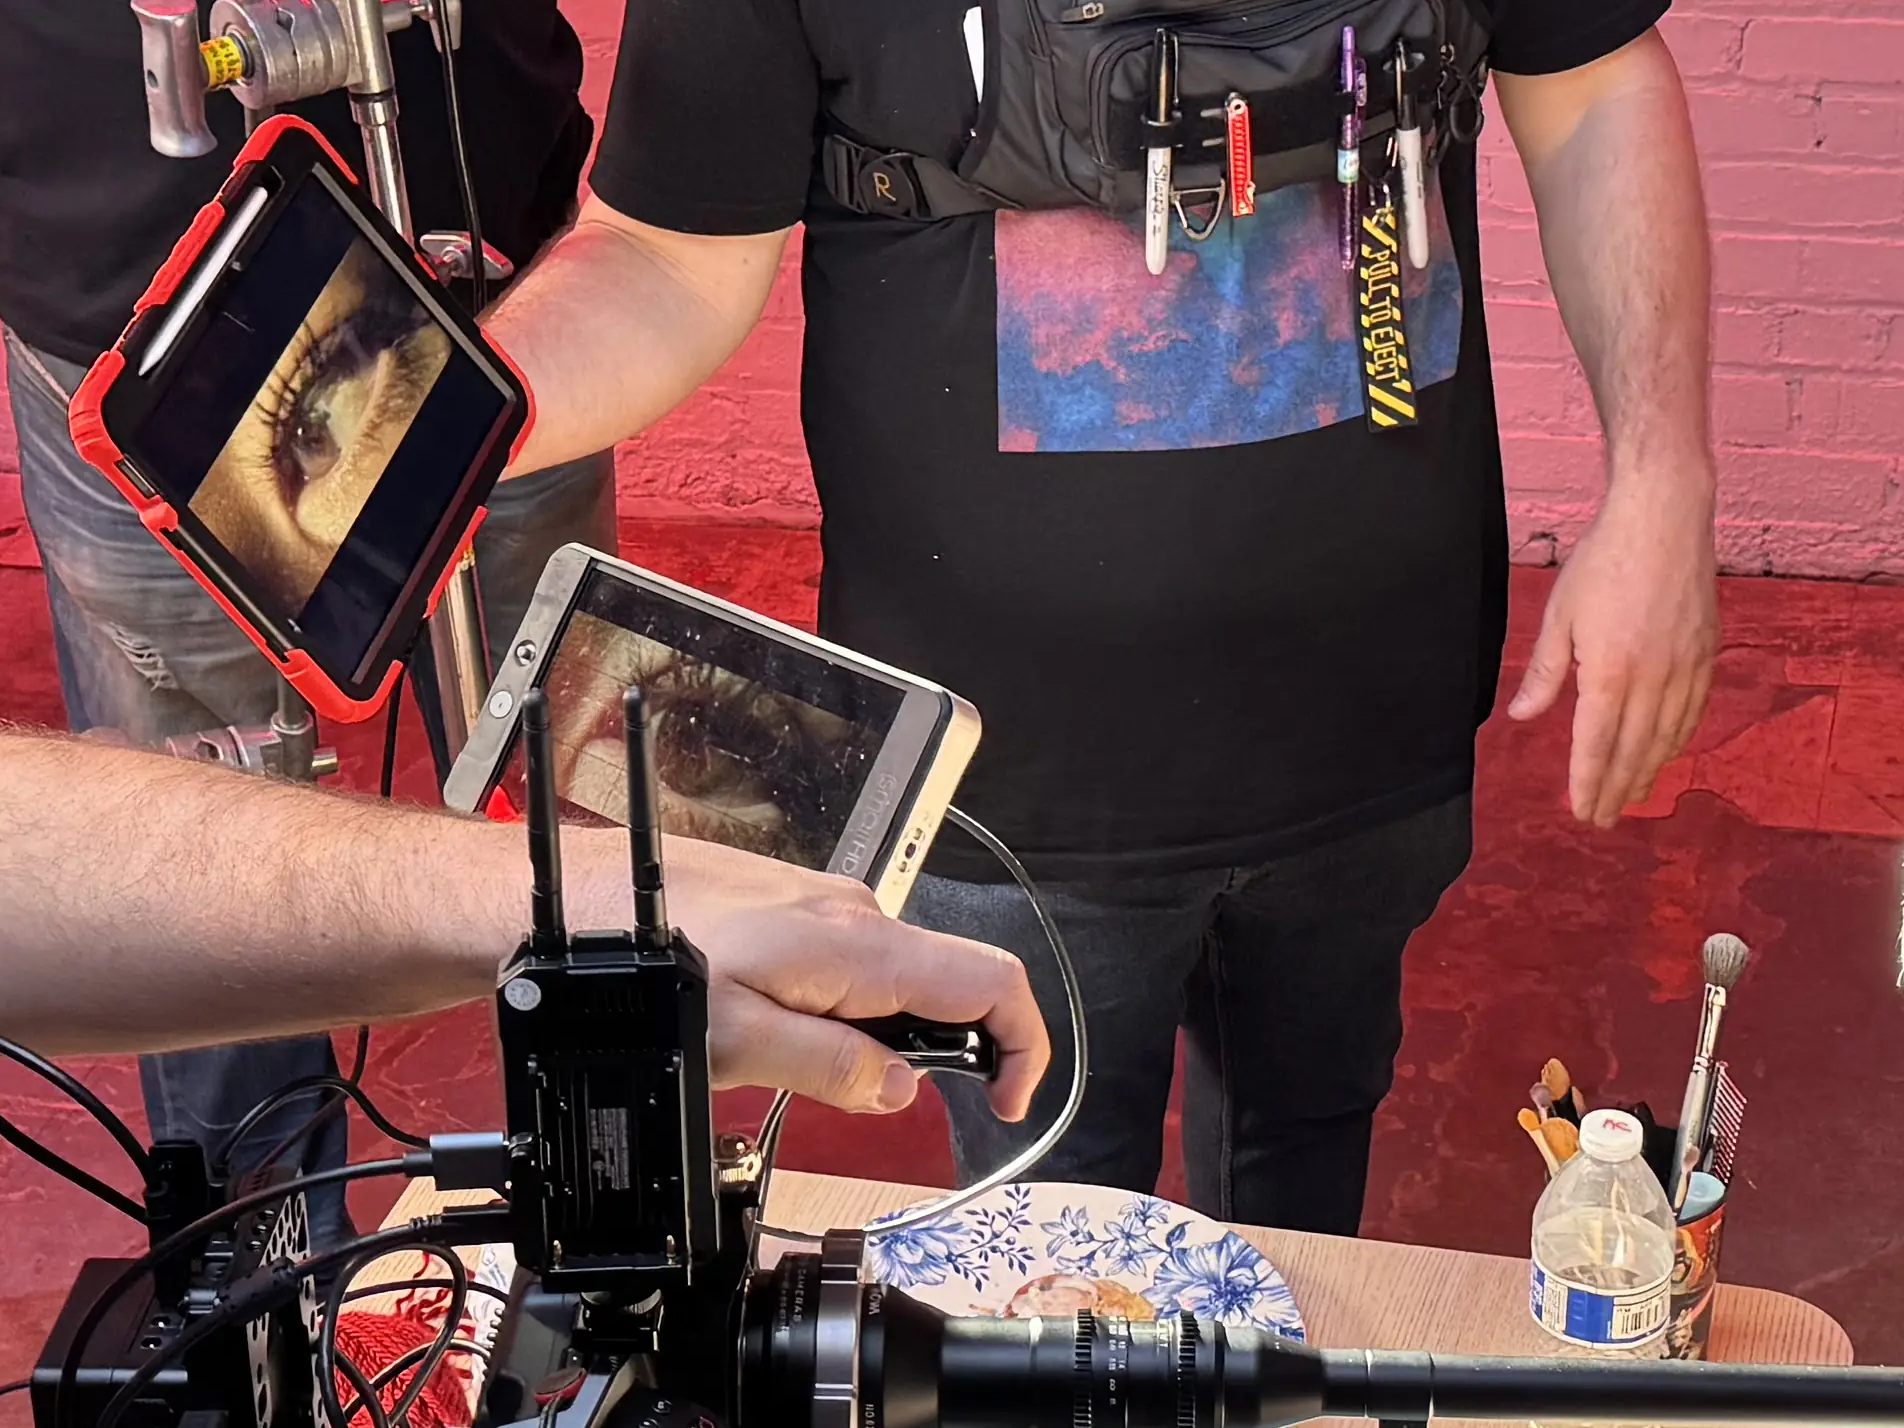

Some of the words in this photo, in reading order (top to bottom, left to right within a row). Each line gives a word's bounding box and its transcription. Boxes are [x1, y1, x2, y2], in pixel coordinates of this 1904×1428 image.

[872, 172, 897, 202] R
[1368, 248, 1393, 297] PULL
[1369, 294, 1392, 324] TO
[1370, 325, 1400, 380] EJECT
